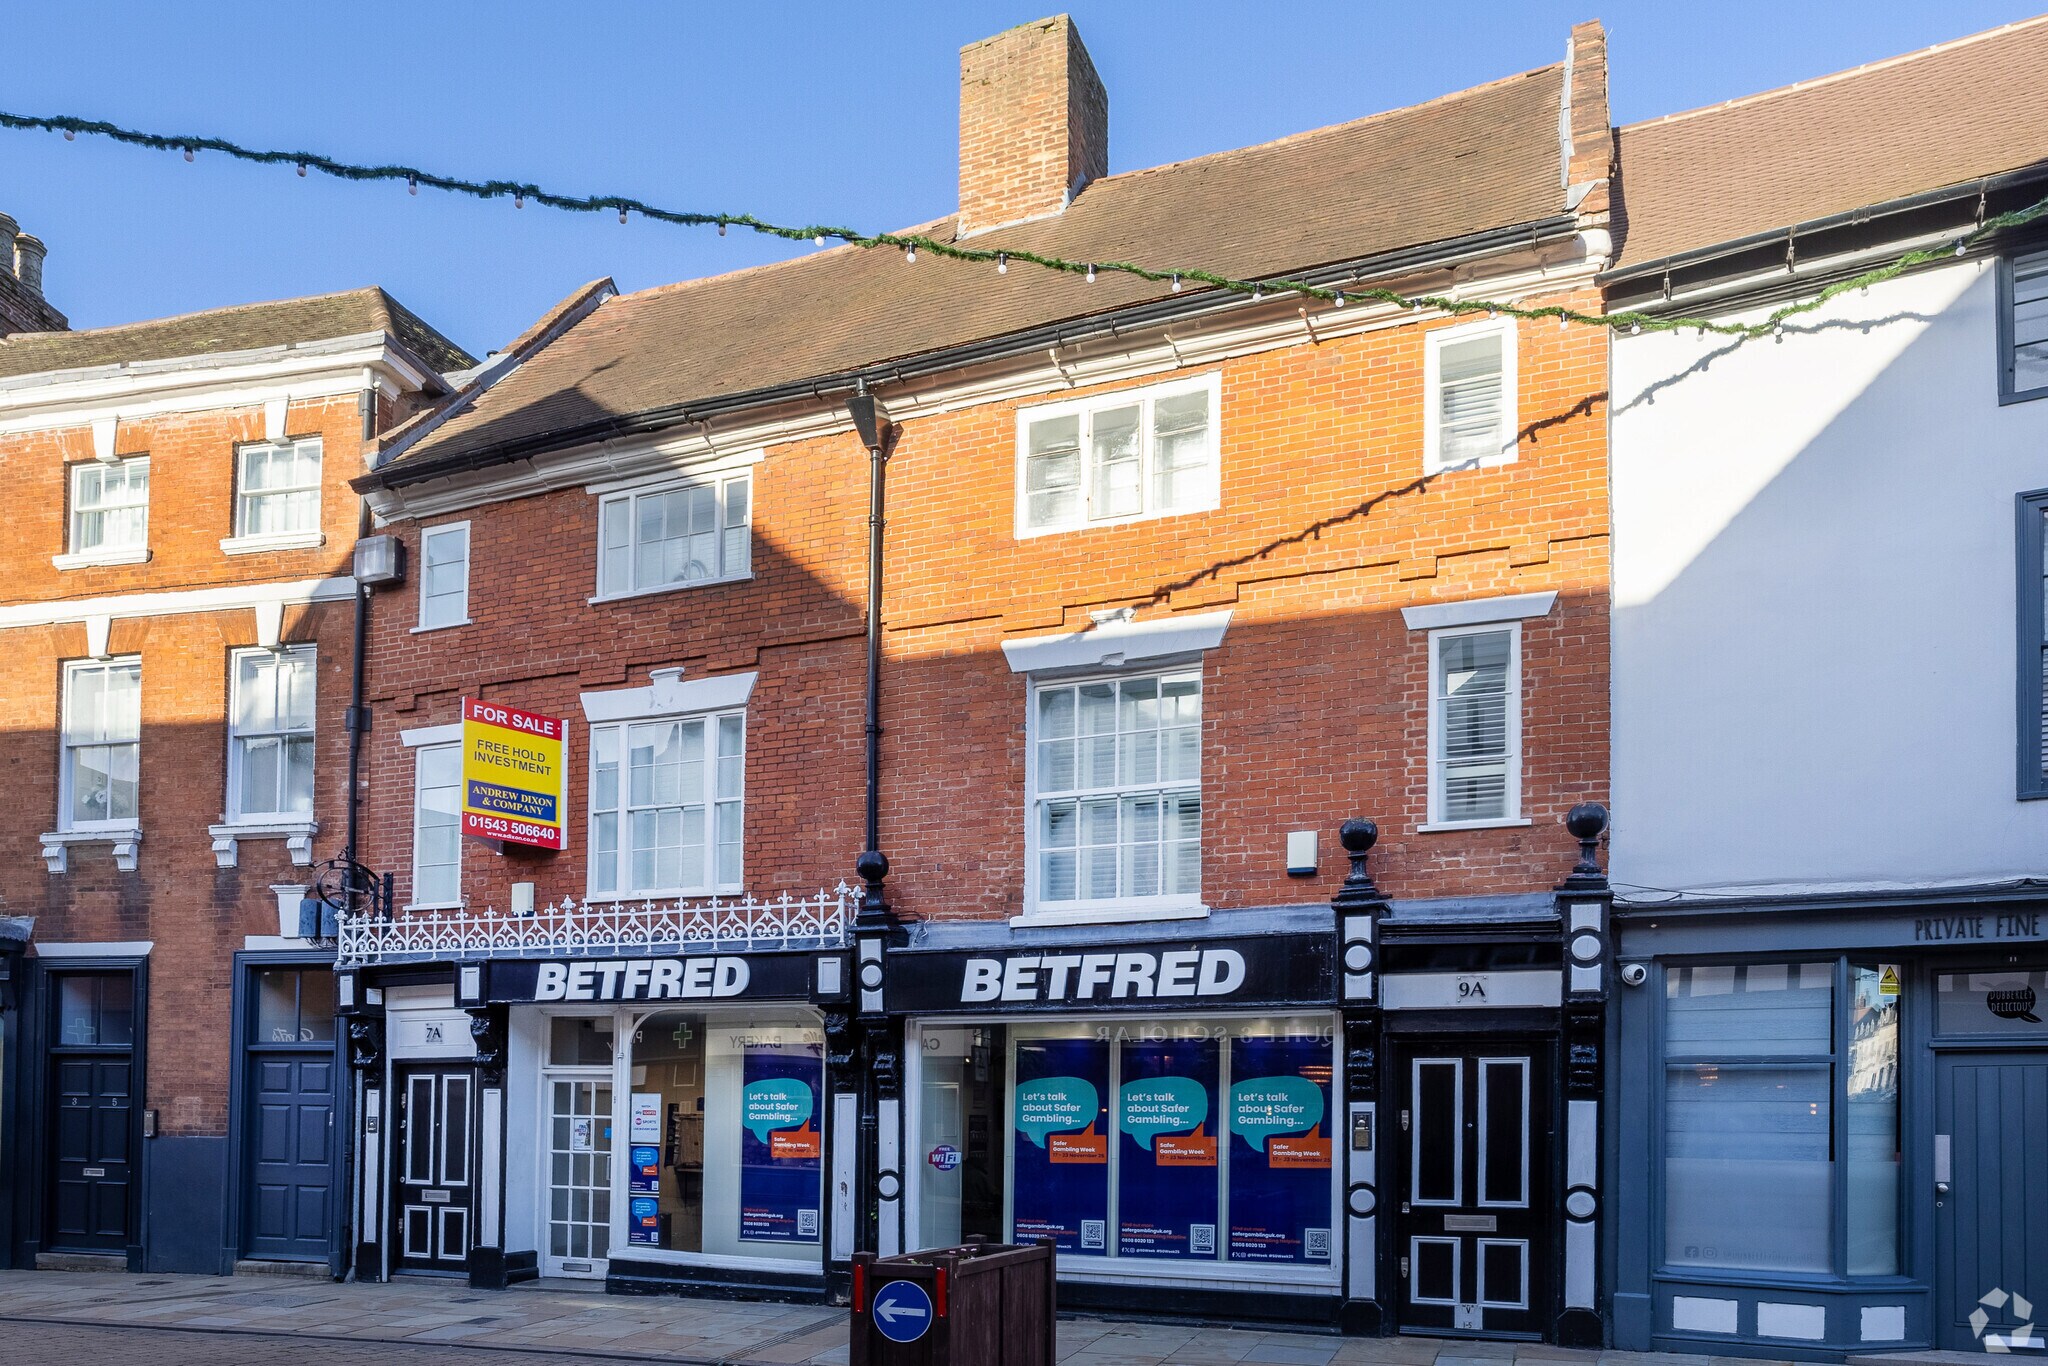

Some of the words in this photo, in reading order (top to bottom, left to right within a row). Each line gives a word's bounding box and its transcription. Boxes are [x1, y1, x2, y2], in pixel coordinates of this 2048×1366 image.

[473, 705, 508, 725] FOR
[513, 714, 554, 735] SALE
[477, 739, 509, 755] FREE
[513, 747, 546, 763] HOLD
[474, 751, 551, 776] INVESTMENT
[472, 786, 518, 800] ANDREW
[521, 794, 553, 808] DIXON
[481, 797, 491, 806] &
[493, 799, 544, 816] COMPANY
[469, 816, 508, 832] 01543
[511, 824, 555, 840] 506640
[487, 830, 539, 844] www.adixon.co.uk
[1915, 917, 1984, 941] PRIVATE
[1996, 914, 2040, 937] FINE
[535, 957, 750, 1000] BETFRED
[960, 949, 1246, 1002] BETFRED
[1459, 981, 1486, 997] 9A
[1990, 990, 2032, 1000] DUBBERLEY
[1991, 1002, 2032, 1012] DELICIOUS
[426, 1027, 441, 1039] 7A
[72, 1097, 77, 1106] 3
[112, 1098, 118, 1106] 5
[1047, 1093, 1067, 1101] talk
[1153, 1093, 1175, 1101] talk
[1266, 1093, 1289, 1101] talk
[775, 1103, 798, 1111] Safer
[1022, 1103, 1052, 1112] about
[1054, 1103, 1081, 1112] Safer
[1127, 1104, 1159, 1113] about
[1161, 1104, 1190, 1113] Safer
[1238, 1104, 1272, 1113] about
[1274, 1104, 1304, 1113] Safer
[748, 1112, 798, 1122] Gambling...
[1022, 1114, 1080, 1125] Gambling...
[1127, 1115, 1189, 1126] Gambling...
[1238, 1116, 1304, 1127] Gambling...
